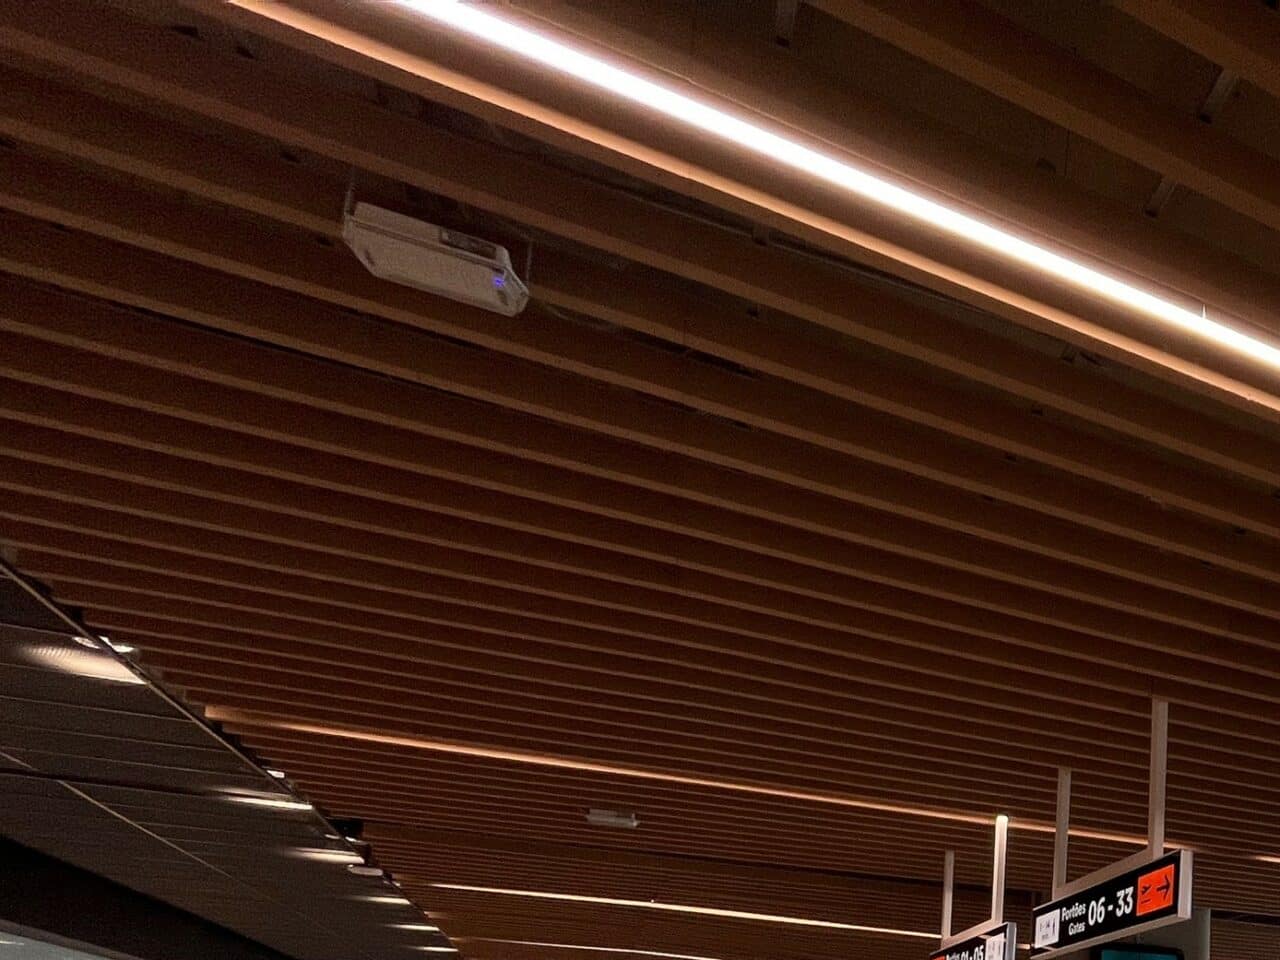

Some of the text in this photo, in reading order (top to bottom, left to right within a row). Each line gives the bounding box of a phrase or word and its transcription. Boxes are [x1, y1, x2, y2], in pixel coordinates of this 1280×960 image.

[1061, 902, 1086, 922] Portões
[1088, 896, 1106, 926] 06
[1115, 886, 1135, 917] 33
[1068, 920, 1086, 936] Gates
